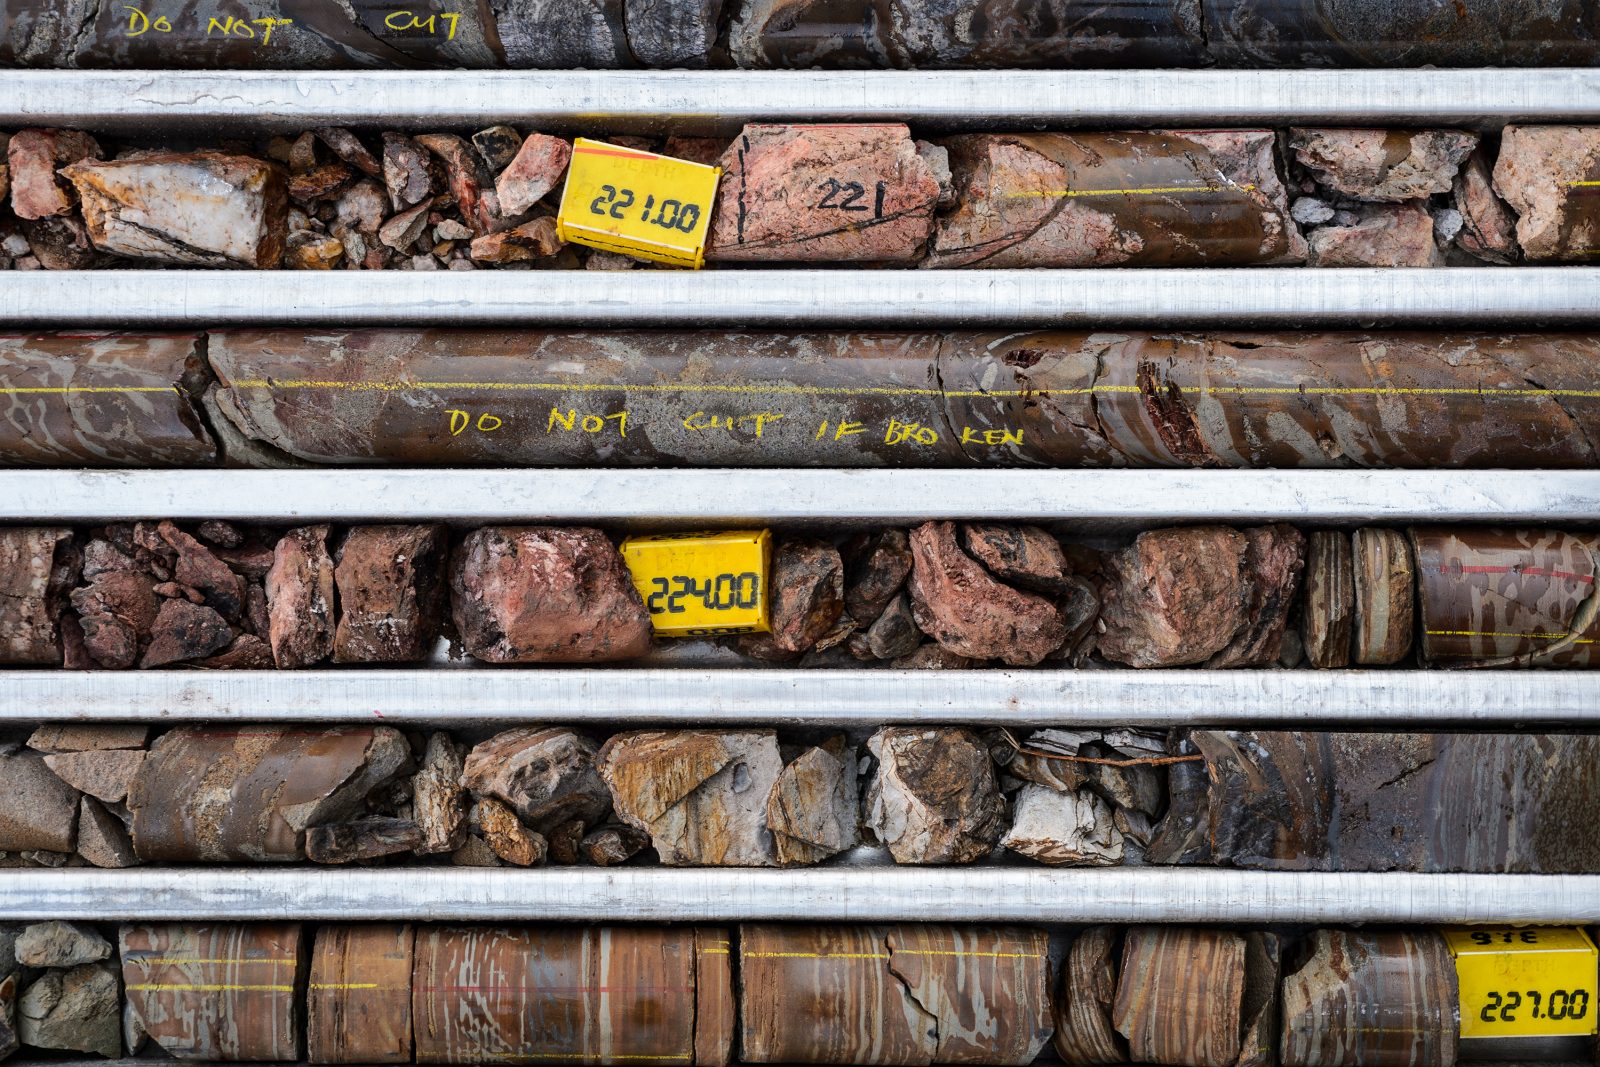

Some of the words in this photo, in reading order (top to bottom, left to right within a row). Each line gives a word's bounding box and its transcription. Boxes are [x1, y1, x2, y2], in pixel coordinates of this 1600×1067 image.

[123, 6, 172, 37] DO
[207, 17, 293, 46] NOT
[384, 11, 463, 41] CUT
[590, 184, 701, 234] 221.00
[817, 177, 887, 219] 221
[445, 409, 503, 437] DO
[546, 407, 631, 438] NOT
[683, 411, 784, 438] CUT
[815, 420, 868, 441] IF
[647, 571, 760, 615] 224.00
[1480, 988, 1590, 1023] 227.00
